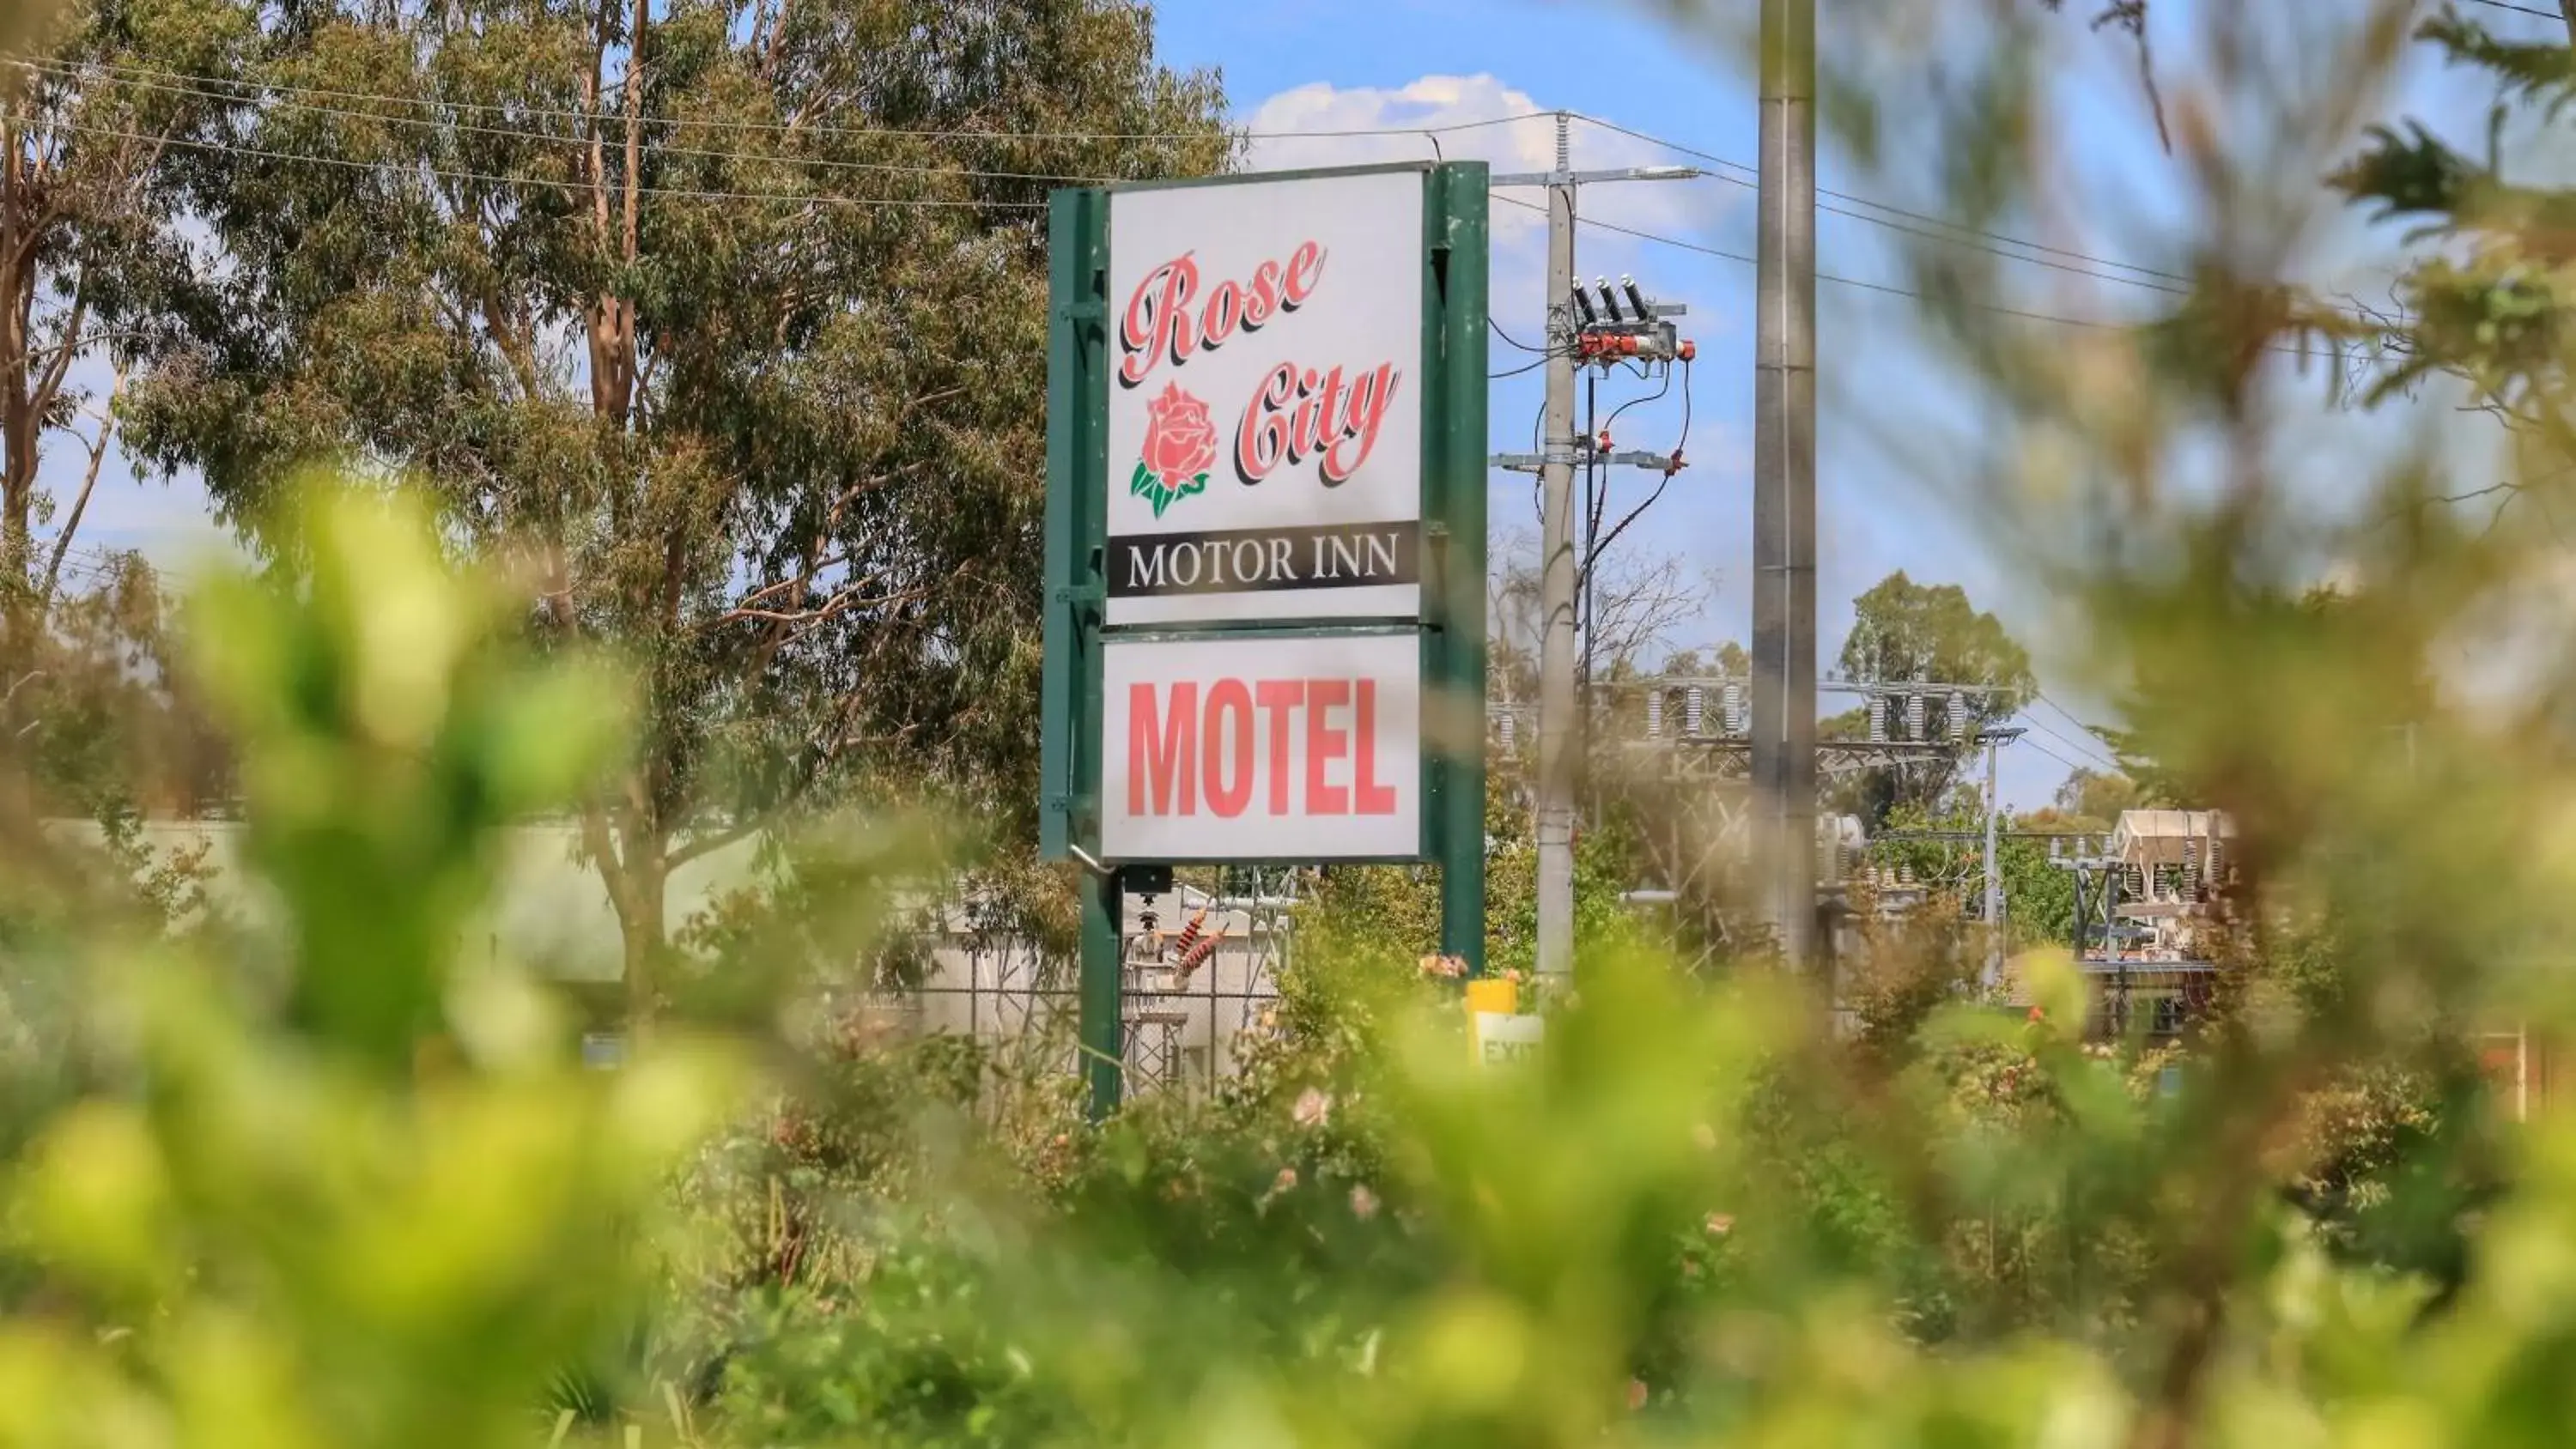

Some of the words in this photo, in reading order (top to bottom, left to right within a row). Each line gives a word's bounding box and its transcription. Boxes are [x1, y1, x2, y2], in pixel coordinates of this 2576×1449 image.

[1119, 240, 1327, 389] Rose
[1235, 361, 1402, 488] City
[1128, 539, 1298, 588] MOTOR
[1312, 533, 1399, 579] INN
[1127, 678, 1396, 818] MOTEL
